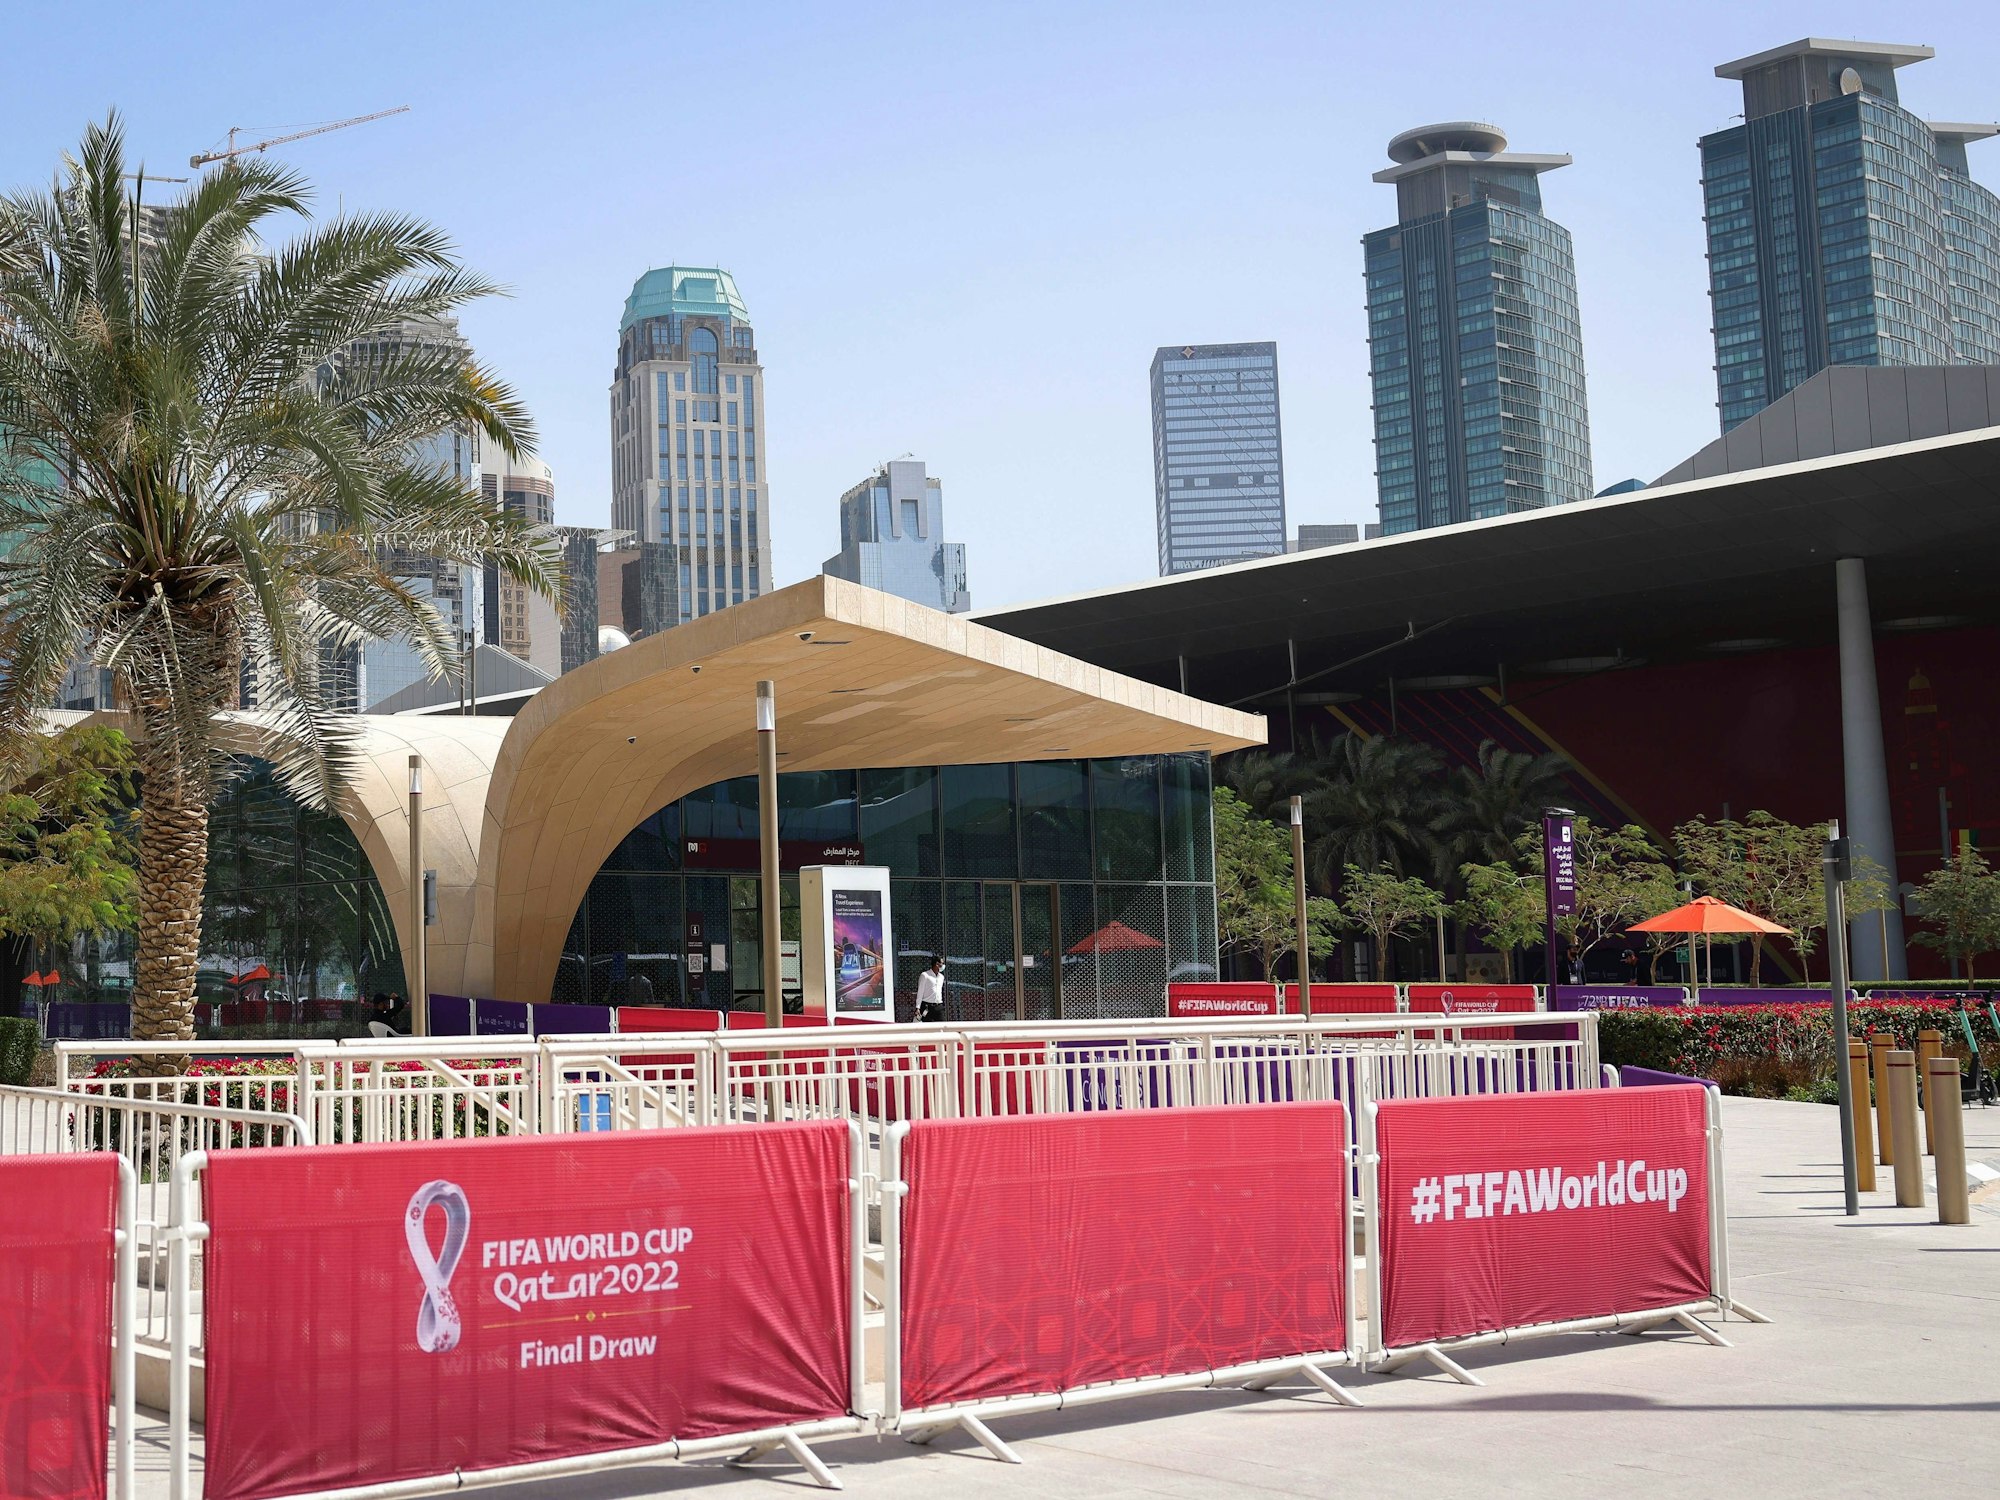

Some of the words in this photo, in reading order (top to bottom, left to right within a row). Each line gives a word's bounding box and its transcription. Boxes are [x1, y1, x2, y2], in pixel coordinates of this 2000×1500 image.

[823, 847, 846, 857] المعارض
[847, 848, 860, 857] مركز
[1178, 1000, 1268, 1014] #FIFAWorldCup
[1609, 995, 1638, 1007] FIFA
[1410, 1160, 1688, 1224] #FIFAWorldCup
[482, 1238, 542, 1268] FIFA
[544, 1230, 639, 1264] WORLD
[644, 1226, 694, 1255] CUP
[493, 1260, 680, 1312] Qatar2022
[520, 1335, 583, 1369] Final
[589, 1334, 658, 1362] Draw
